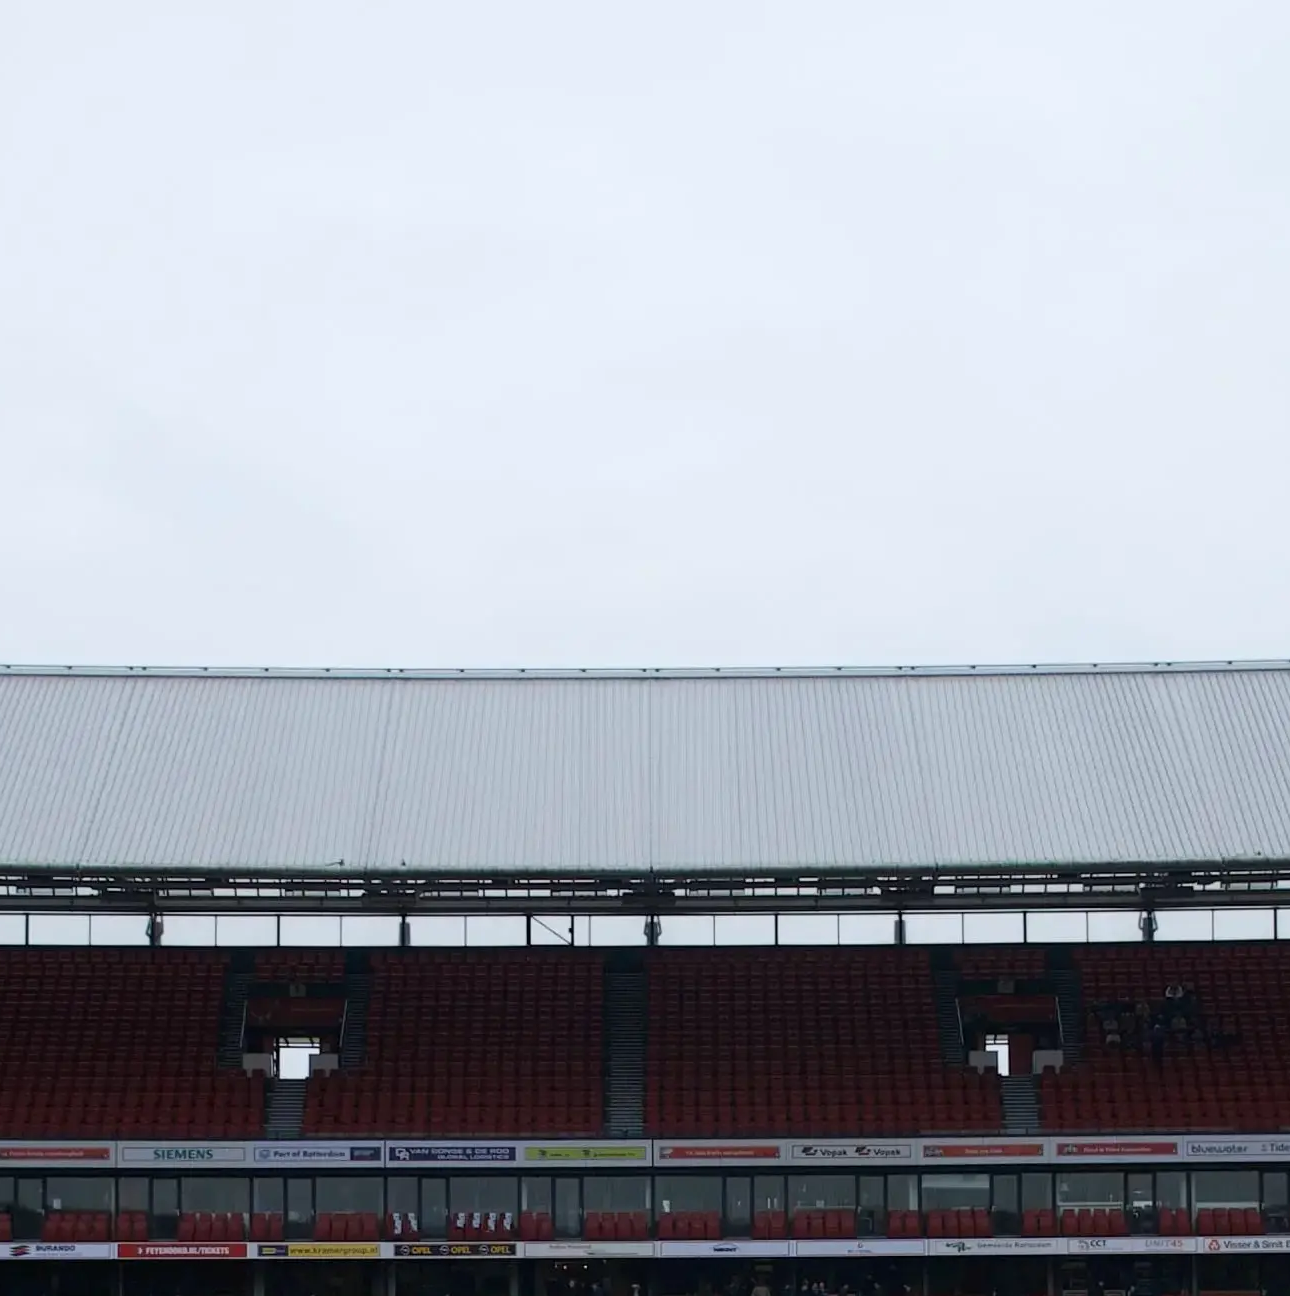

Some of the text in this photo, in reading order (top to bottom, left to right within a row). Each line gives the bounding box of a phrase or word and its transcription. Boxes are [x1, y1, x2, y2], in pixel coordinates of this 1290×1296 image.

[819, 1148, 849, 1158] Vopak
[873, 1147, 902, 1157] Vopak
[1190, 1143, 1250, 1154] bluewater
[152, 1149, 214, 1160] SIEMENS
[1090, 1239, 1107, 1248] CCT
[1223, 1240, 1251, 1250] Visser
[1253, 1239, 1262, 1249] &
[1264, 1239, 1284, 1249] Smit
[411, 1246, 433, 1255] OPEL
[451, 1246, 473, 1255] OPEL
[490, 1245, 512, 1255] OPEL
